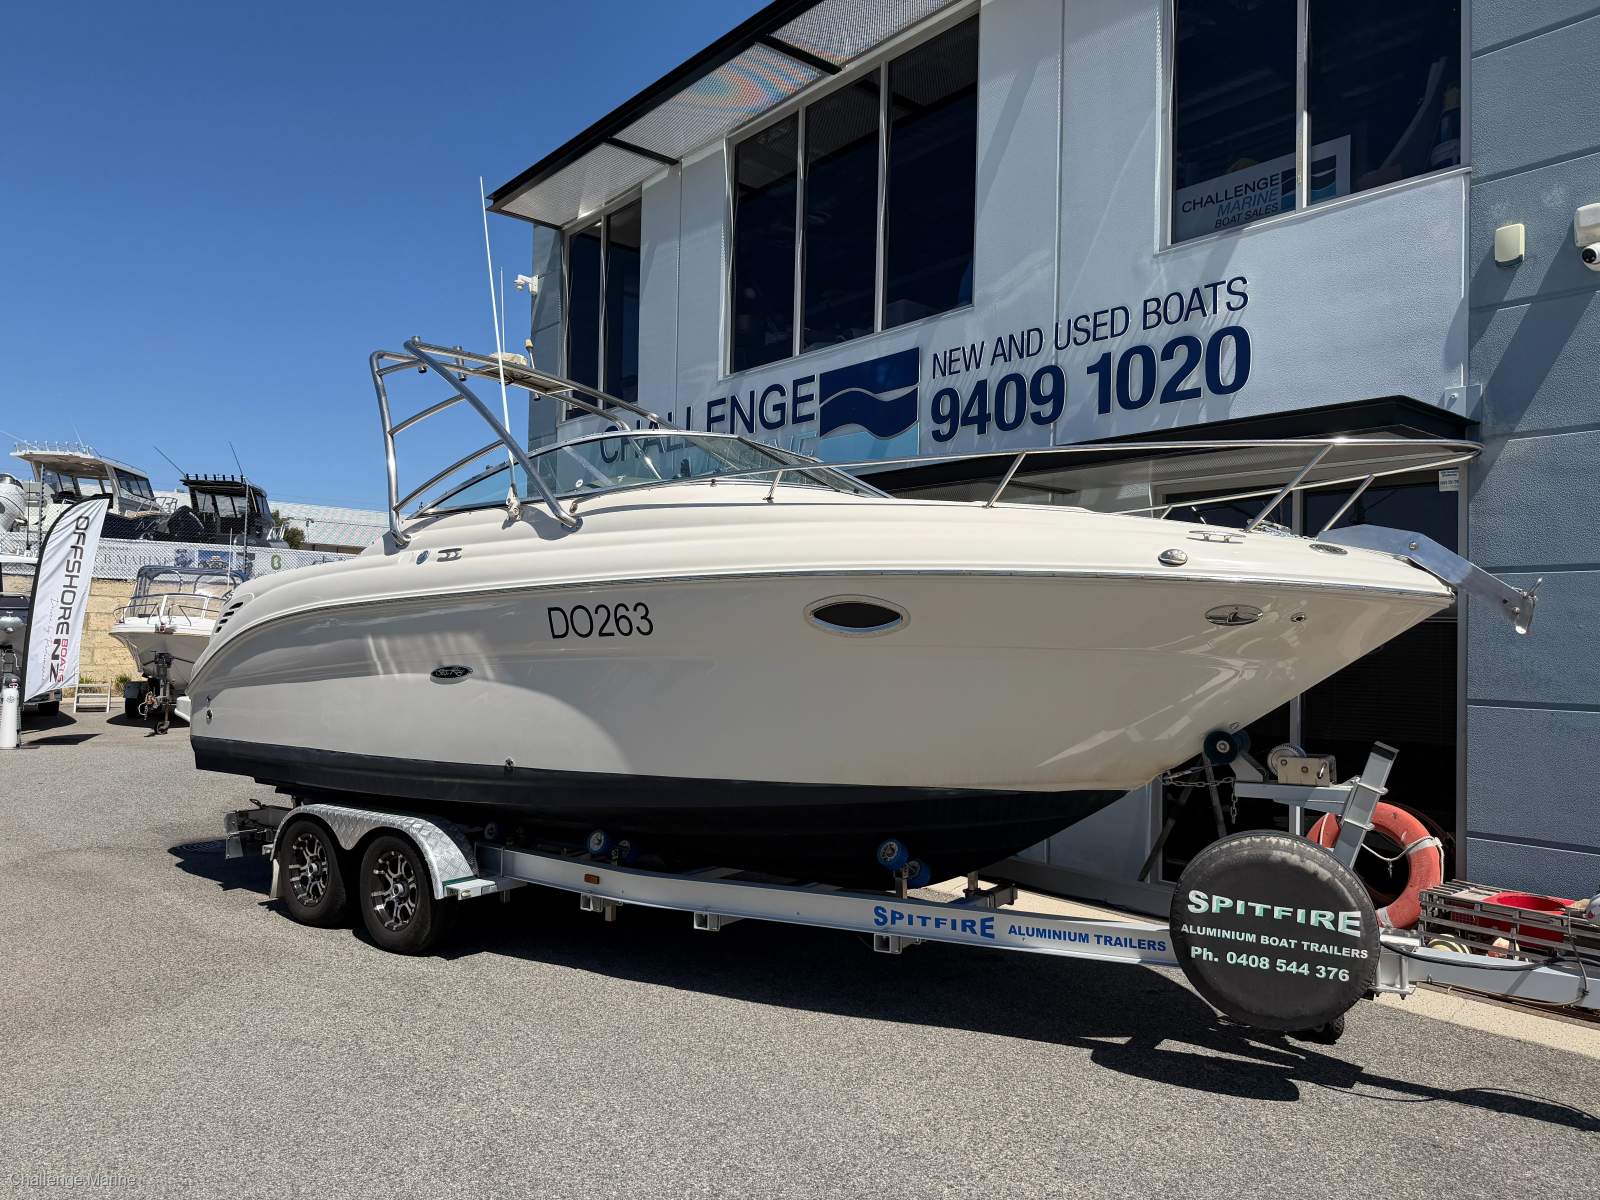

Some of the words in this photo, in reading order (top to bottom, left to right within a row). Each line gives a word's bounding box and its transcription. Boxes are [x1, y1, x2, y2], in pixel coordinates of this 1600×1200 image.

[1182, 173, 1280, 213] CHALLENGE
[1214, 213, 1242, 229] BOAT
[1245, 202, 1279, 220] SALES
[1217, 187, 1280, 217] MARINE
[932, 341, 985, 379] NEW
[990, 328, 1044, 366] AND
[1054, 306, 1130, 350] USED
[1142, 276, 1250, 331] BOATS
[930, 365, 1066, 443] 9409
[1086, 326, 1251, 415] 1020
[55, 515, 89, 635] OFFSHORE
[547, 602, 653, 639] DO263
[50, 638, 61, 683] NZ
[57, 638, 69, 683] BOATS
[873, 905, 995, 939] SPITFIRE
[1008, 924, 1090, 944] ALUMINIUM
[1094, 934, 1166, 952] TRAILERS
[1187, 889, 1361, 937] SPITFIRE
[1181, 924, 1257, 943] ALUMINIUM
[1260, 935, 1298, 949] BOAT
[1301, 941, 1369, 959] TRAILERS
[1190, 946, 1219, 962] Ph.
[1226, 951, 1270, 970] 0408
[1275, 959, 1310, 976] 544
[1315, 965, 1350, 982] 376
